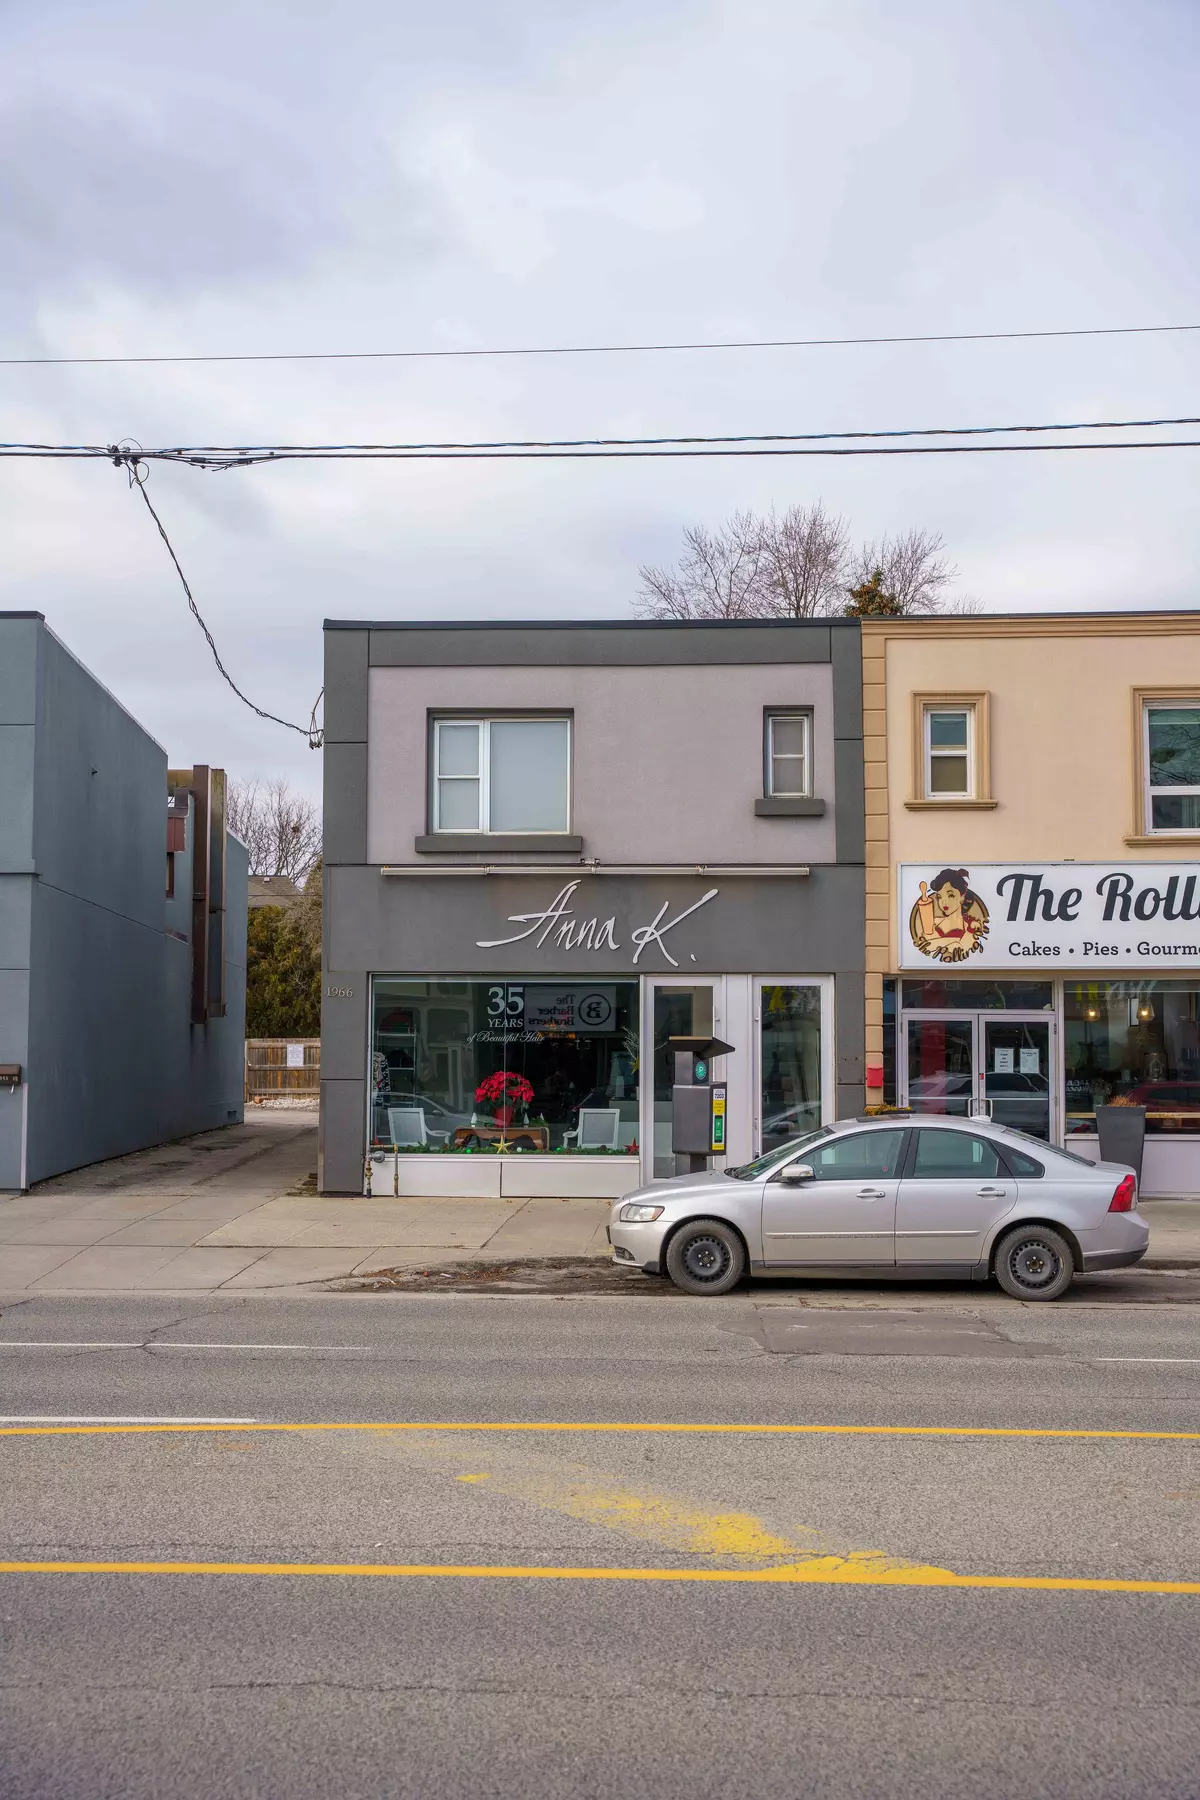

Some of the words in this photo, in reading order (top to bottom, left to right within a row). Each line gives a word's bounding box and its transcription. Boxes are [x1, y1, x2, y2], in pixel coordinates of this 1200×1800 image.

[996, 873, 1083, 922] The
[1096, 872, 1200, 922] Roll
[476, 879, 621, 951] Anna
[913, 936, 932, 956] The
[931, 940, 984, 963] Rolling
[1008, 941, 1061, 956] Cakes
[1083, 941, 1119, 956] Pies
[1137, 941, 1200, 956] Gourm
[327, 986, 353, 998] 1966
[487, 986, 525, 1015] 35
[488, 1018, 524, 1028] YEARS
[466, 1032, 477, 1045] of
[477, 1030, 520, 1045] Beautiful
[520, 1030, 545, 1043] Hair
